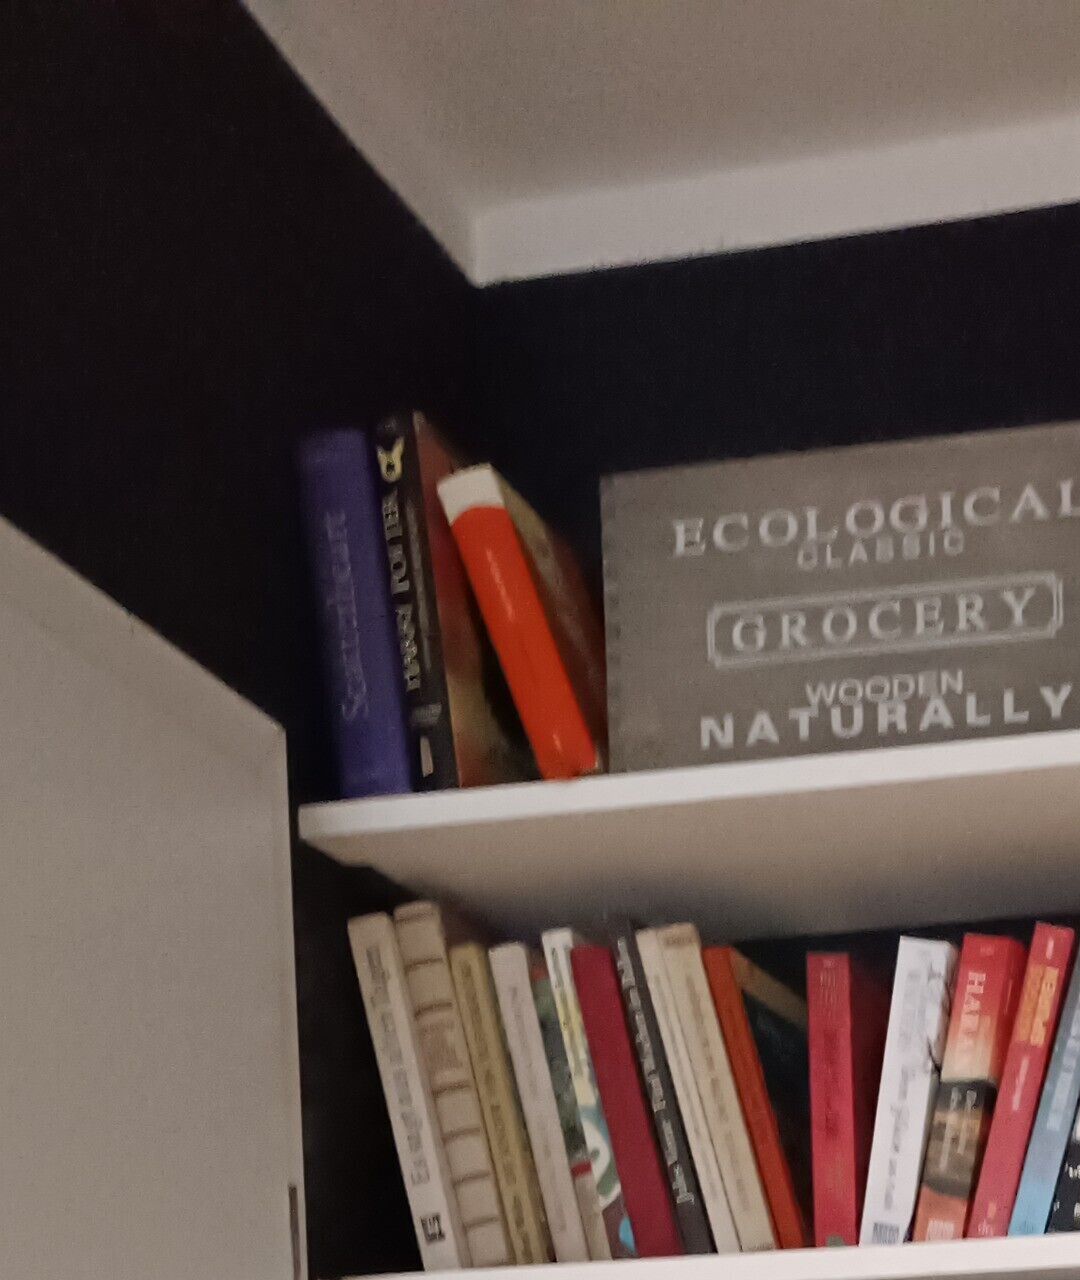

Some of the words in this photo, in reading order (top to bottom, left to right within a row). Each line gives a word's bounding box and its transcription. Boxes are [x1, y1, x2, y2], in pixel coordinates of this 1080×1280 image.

[797, 529, 966, 571] CLASSIC
[731, 585, 1038, 653] GROCERY
[805, 667, 964, 709] WOODEN
[699, 683, 1073, 750] NATURALLY
